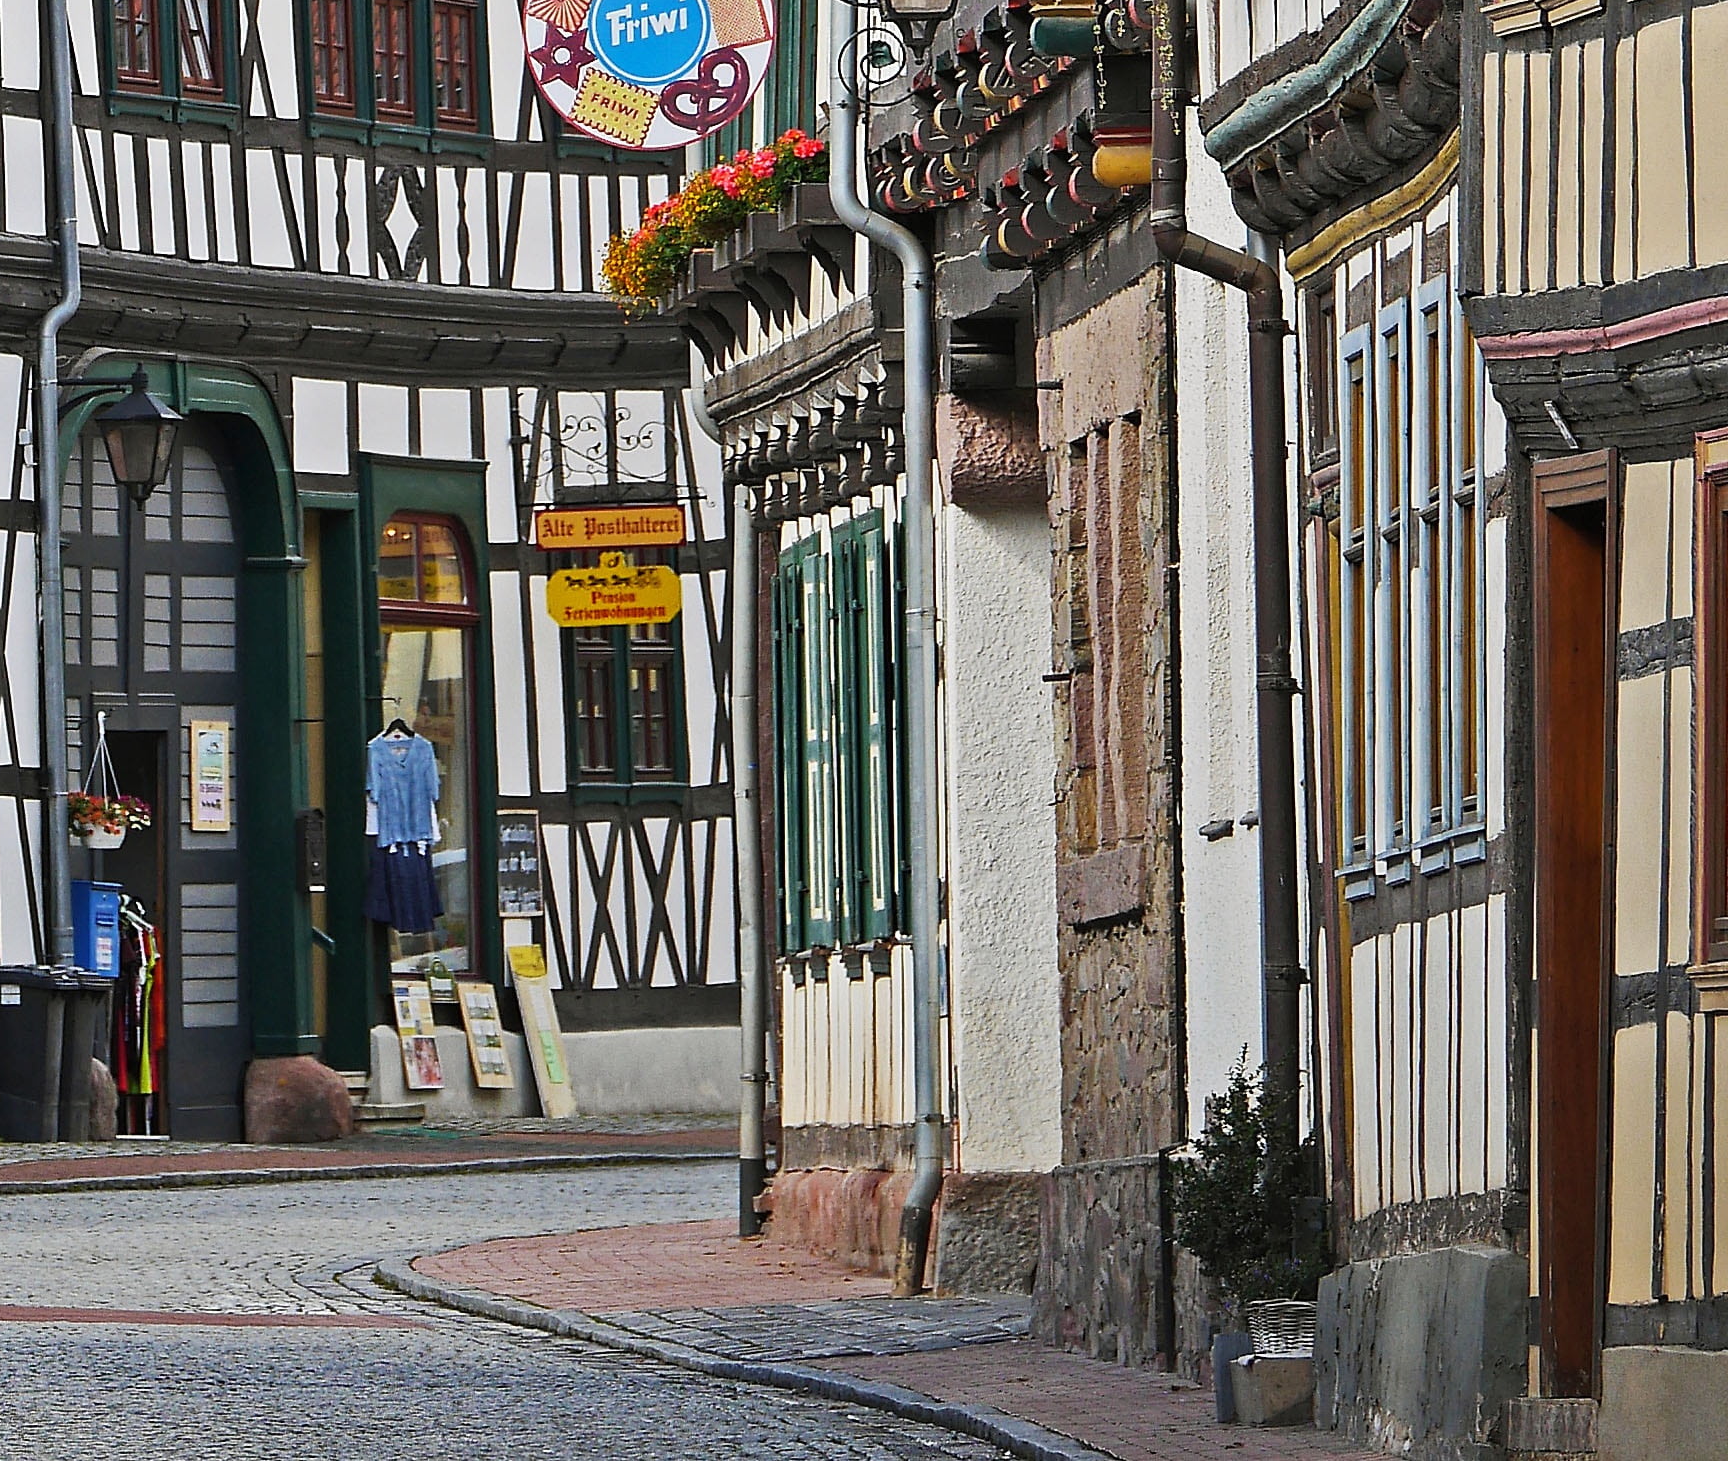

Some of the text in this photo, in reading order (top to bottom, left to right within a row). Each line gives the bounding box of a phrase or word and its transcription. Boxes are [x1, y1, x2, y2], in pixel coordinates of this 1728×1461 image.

[591, 92, 640, 120] FRIWI
[541, 514, 680, 541] Alte Posthalterei
